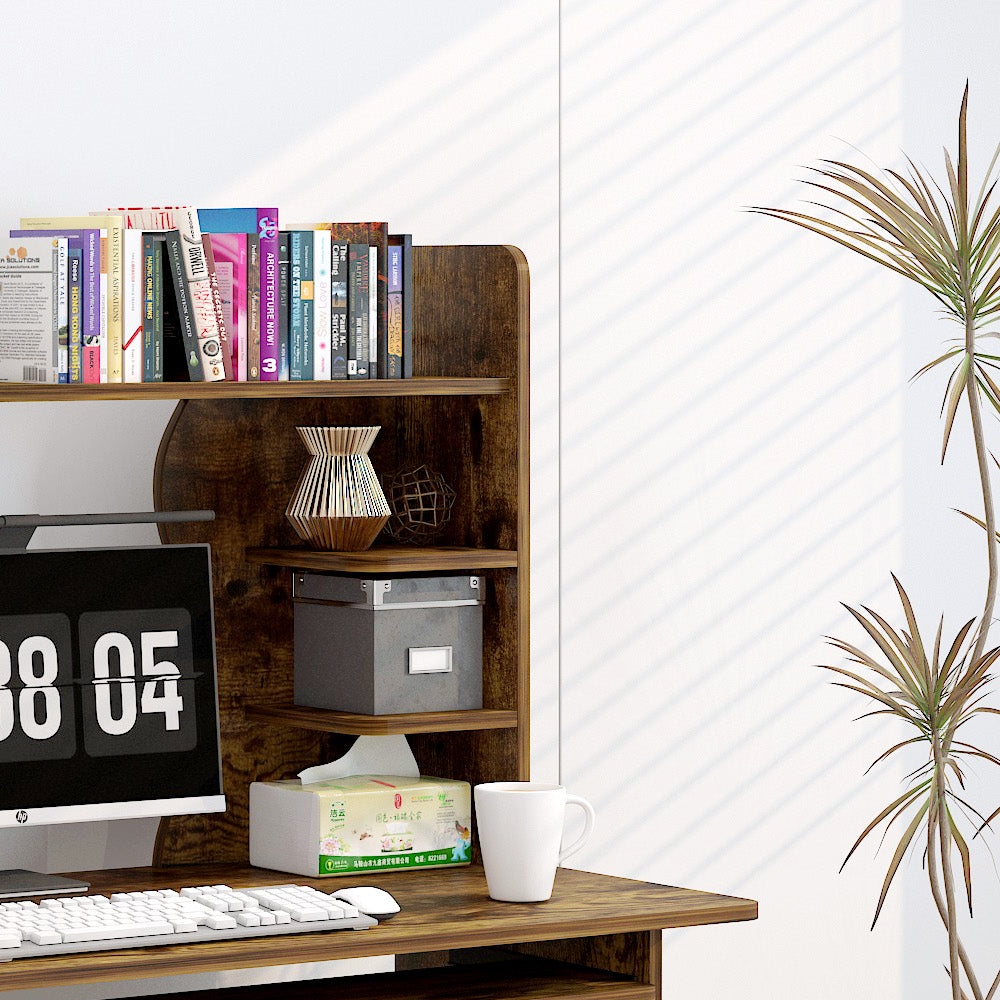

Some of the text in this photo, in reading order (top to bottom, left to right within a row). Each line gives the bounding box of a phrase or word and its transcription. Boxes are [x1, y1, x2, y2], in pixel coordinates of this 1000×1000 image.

[188, 247, 204, 275] ORWELL
[292, 233, 300, 266] RIDERS
[331, 244, 340, 276] Calling
[339, 244, 347, 262] The
[59, 272, 65, 281] AT
[174, 261, 183, 277] AND
[292, 266, 300, 279] ON
[357, 253, 369, 293] VAMPIRE
[176, 277, 185, 289] THE
[292, 279, 300, 297] THE
[71, 286, 79, 314] HONG
[177, 289, 189, 315] POTION
[262, 252, 277, 373] ARCHITECTURE NOW! 3
[292, 297, 300, 327] STORM
[317, 281, 328, 338] Slow Love
[71, 316, 79, 343] KONG
[218, 325, 227, 342] OUT
[340, 335, 347, 347] M.
[71, 345, 79, 381] NIGHTS
[15, 809, 29, 824] hp
